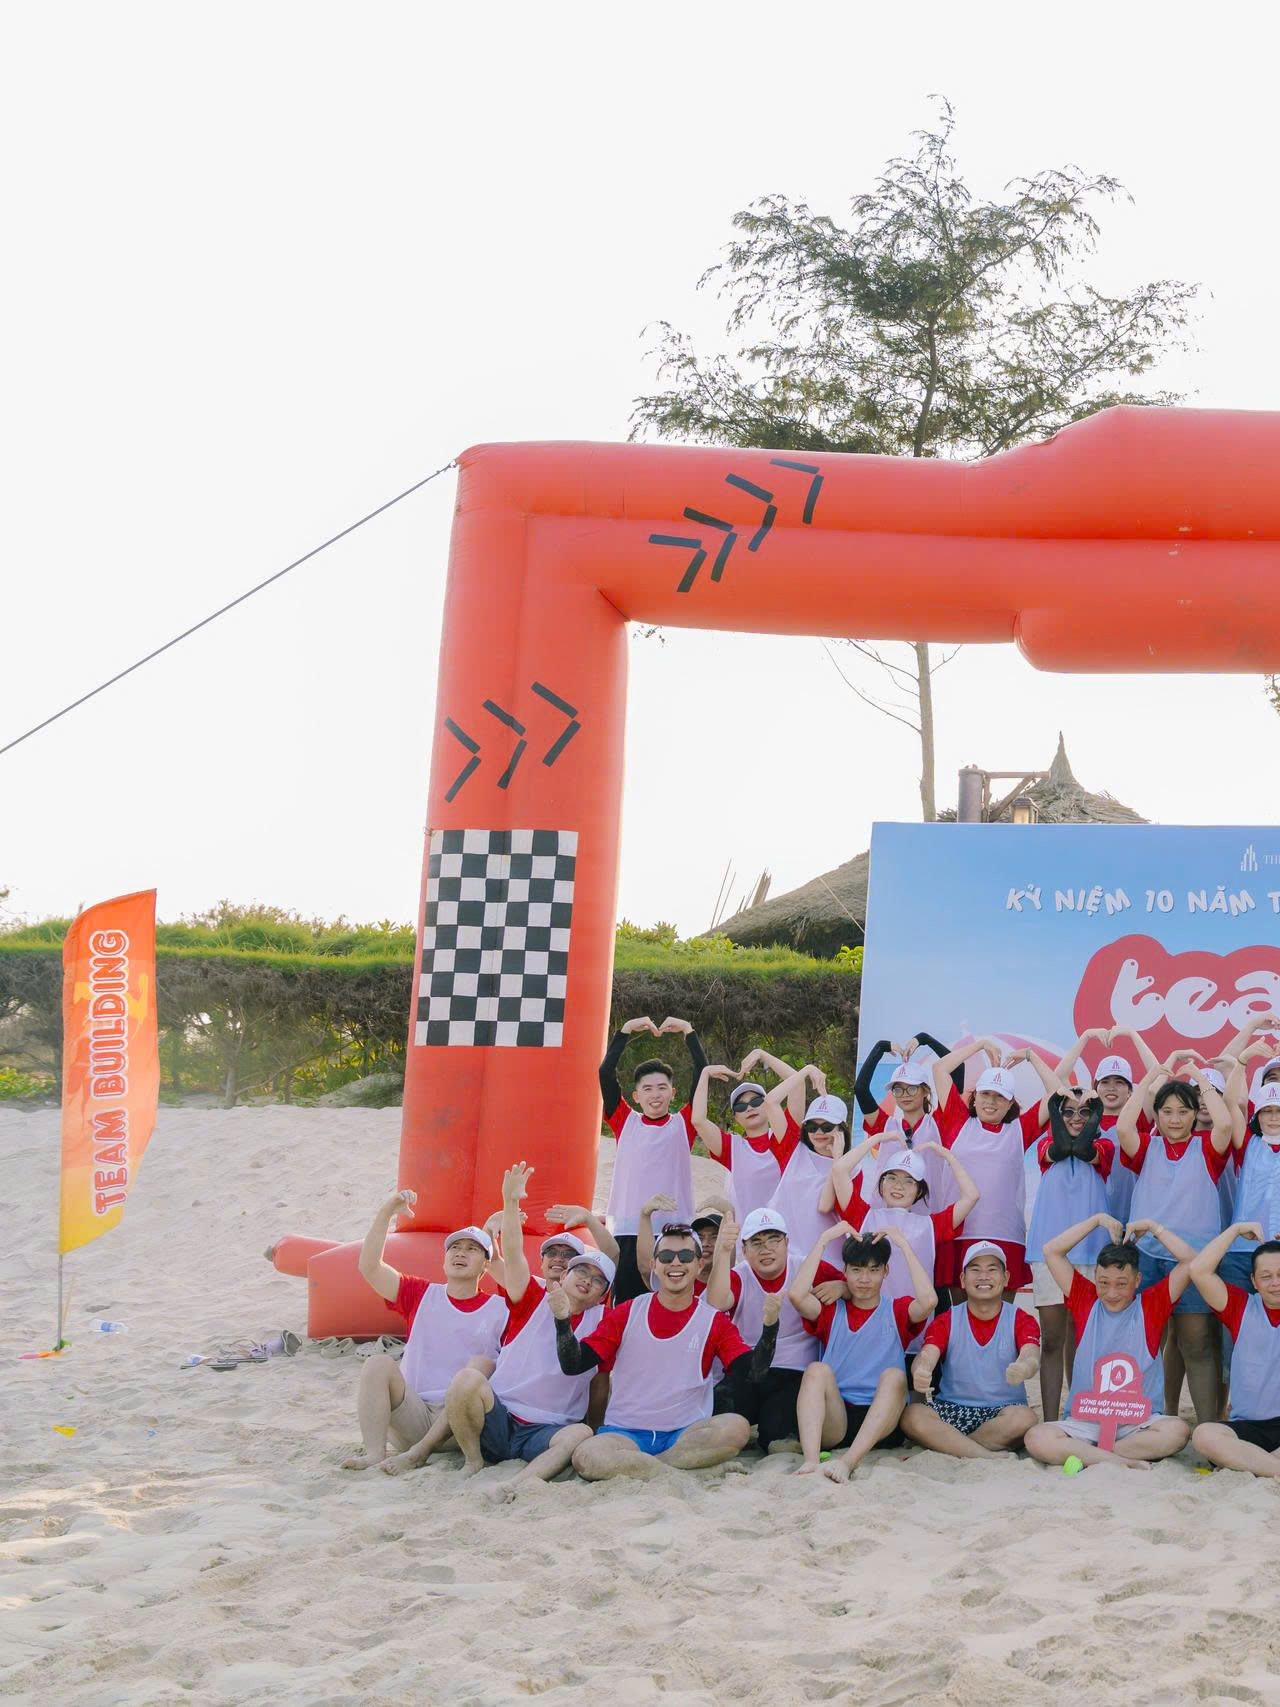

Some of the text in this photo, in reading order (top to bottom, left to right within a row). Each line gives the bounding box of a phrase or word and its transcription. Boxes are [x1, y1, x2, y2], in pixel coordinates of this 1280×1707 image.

[1006, 884, 1042, 912] KỶ
[1055, 885, 1132, 916] NIỆM
[1145, 890, 1174, 912] 10
[1187, 886, 1256, 916] NĂM
[90, 929, 129, 1216] TEAM BUILDING
[1100, 1359, 1134, 1394] 10
